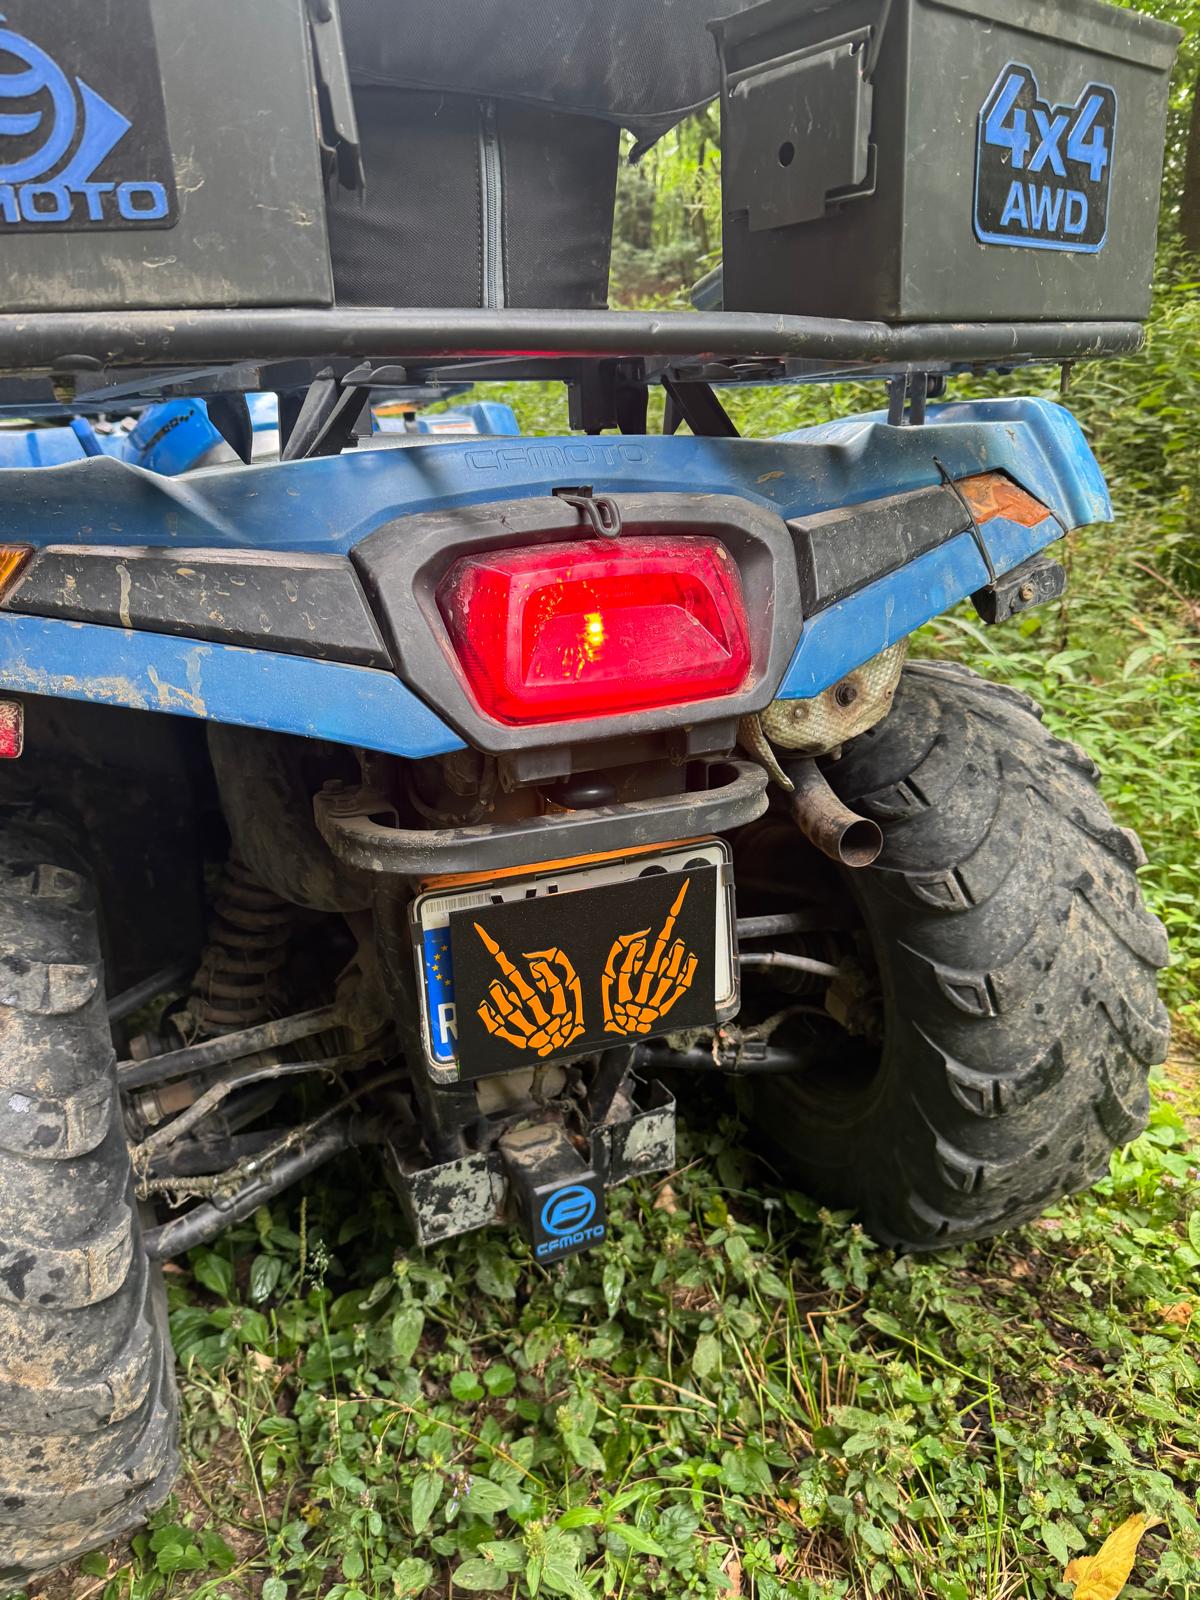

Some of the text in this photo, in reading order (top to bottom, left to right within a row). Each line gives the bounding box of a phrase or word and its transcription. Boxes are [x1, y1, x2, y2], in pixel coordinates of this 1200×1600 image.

[1000, 180, 1089, 234] AWD
[464, 444, 649, 471] CFMOTO
[536, 1224, 605, 1257] CFMOTO
